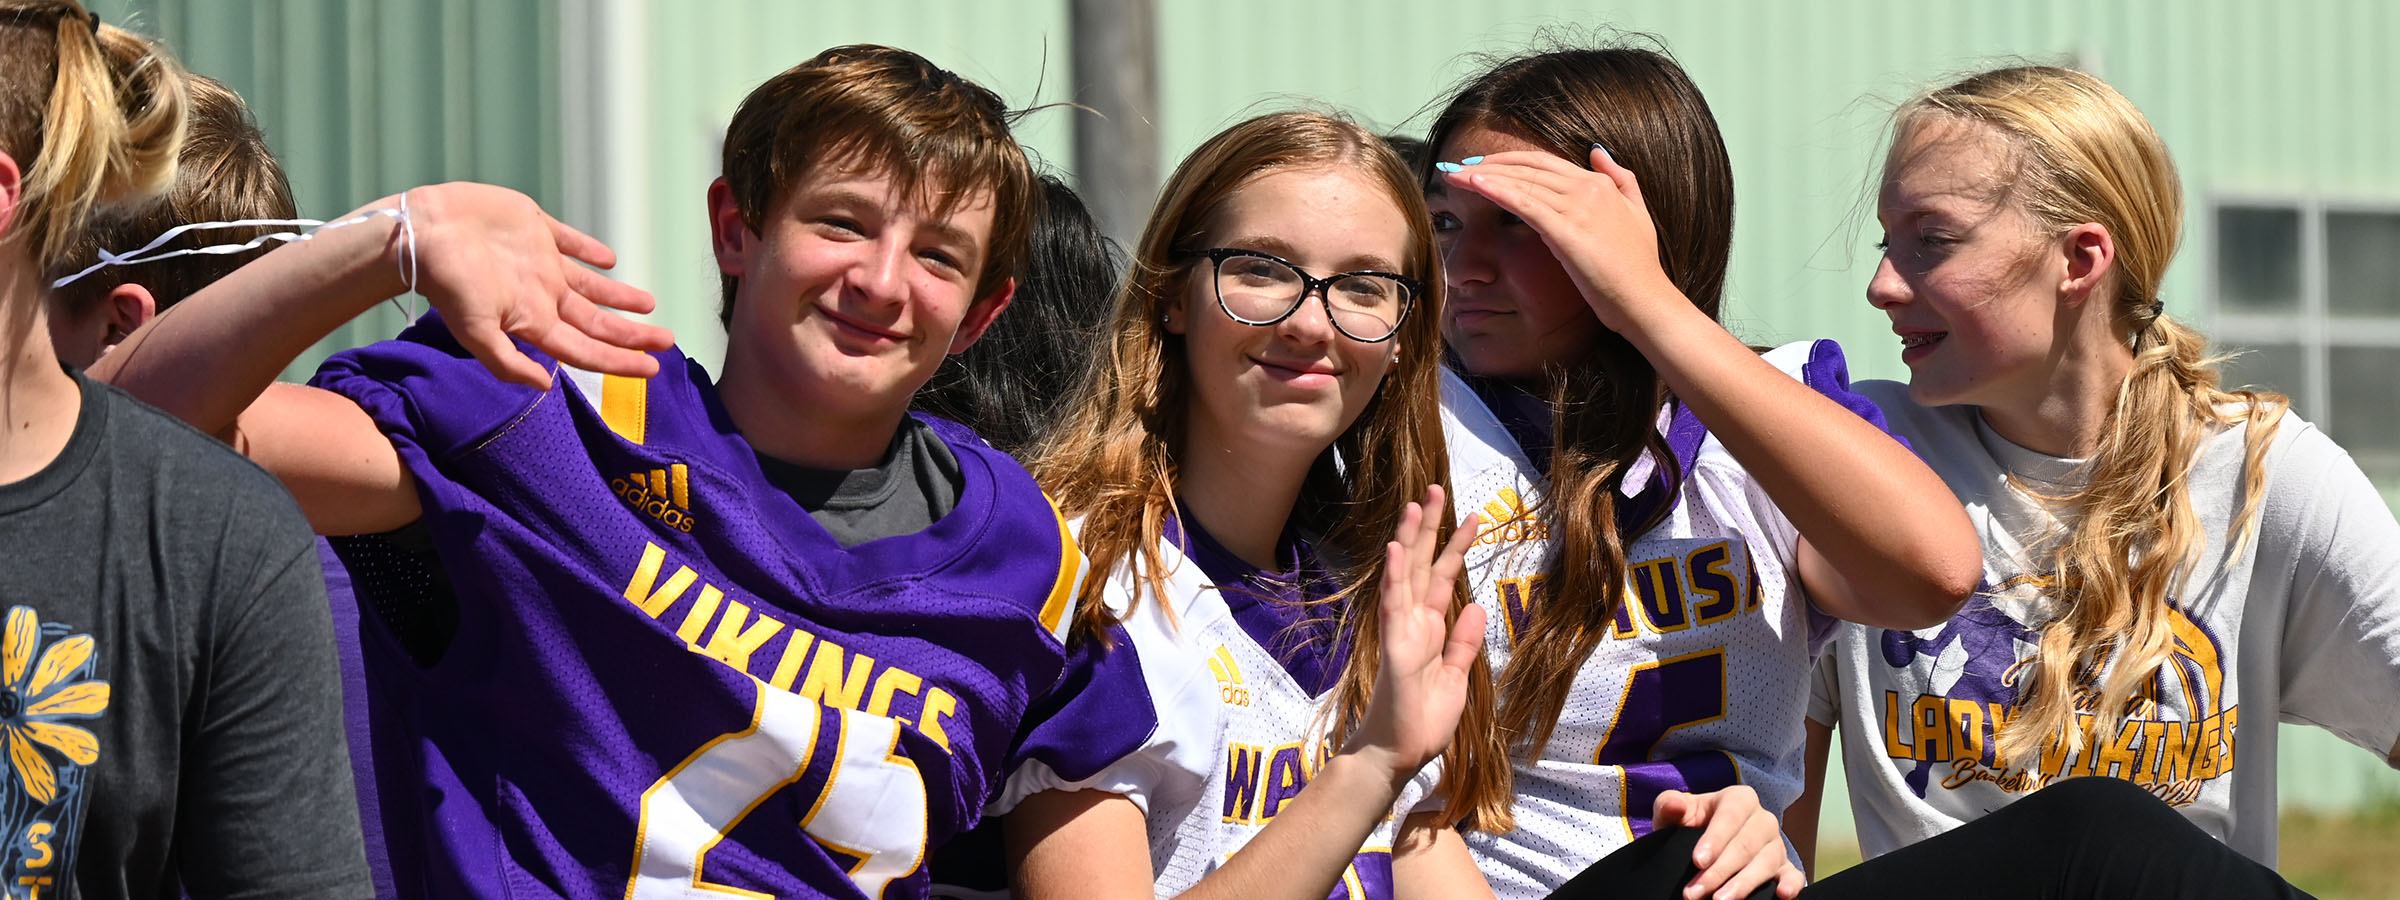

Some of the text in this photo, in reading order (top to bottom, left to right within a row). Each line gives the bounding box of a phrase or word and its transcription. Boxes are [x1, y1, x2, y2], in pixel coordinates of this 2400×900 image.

[611, 478, 696, 533] adidas
[1471, 519, 1552, 547] didas
[623, 540, 957, 756] VIKINGS
[1885, 689, 2239, 786] LADY VIKINGS
